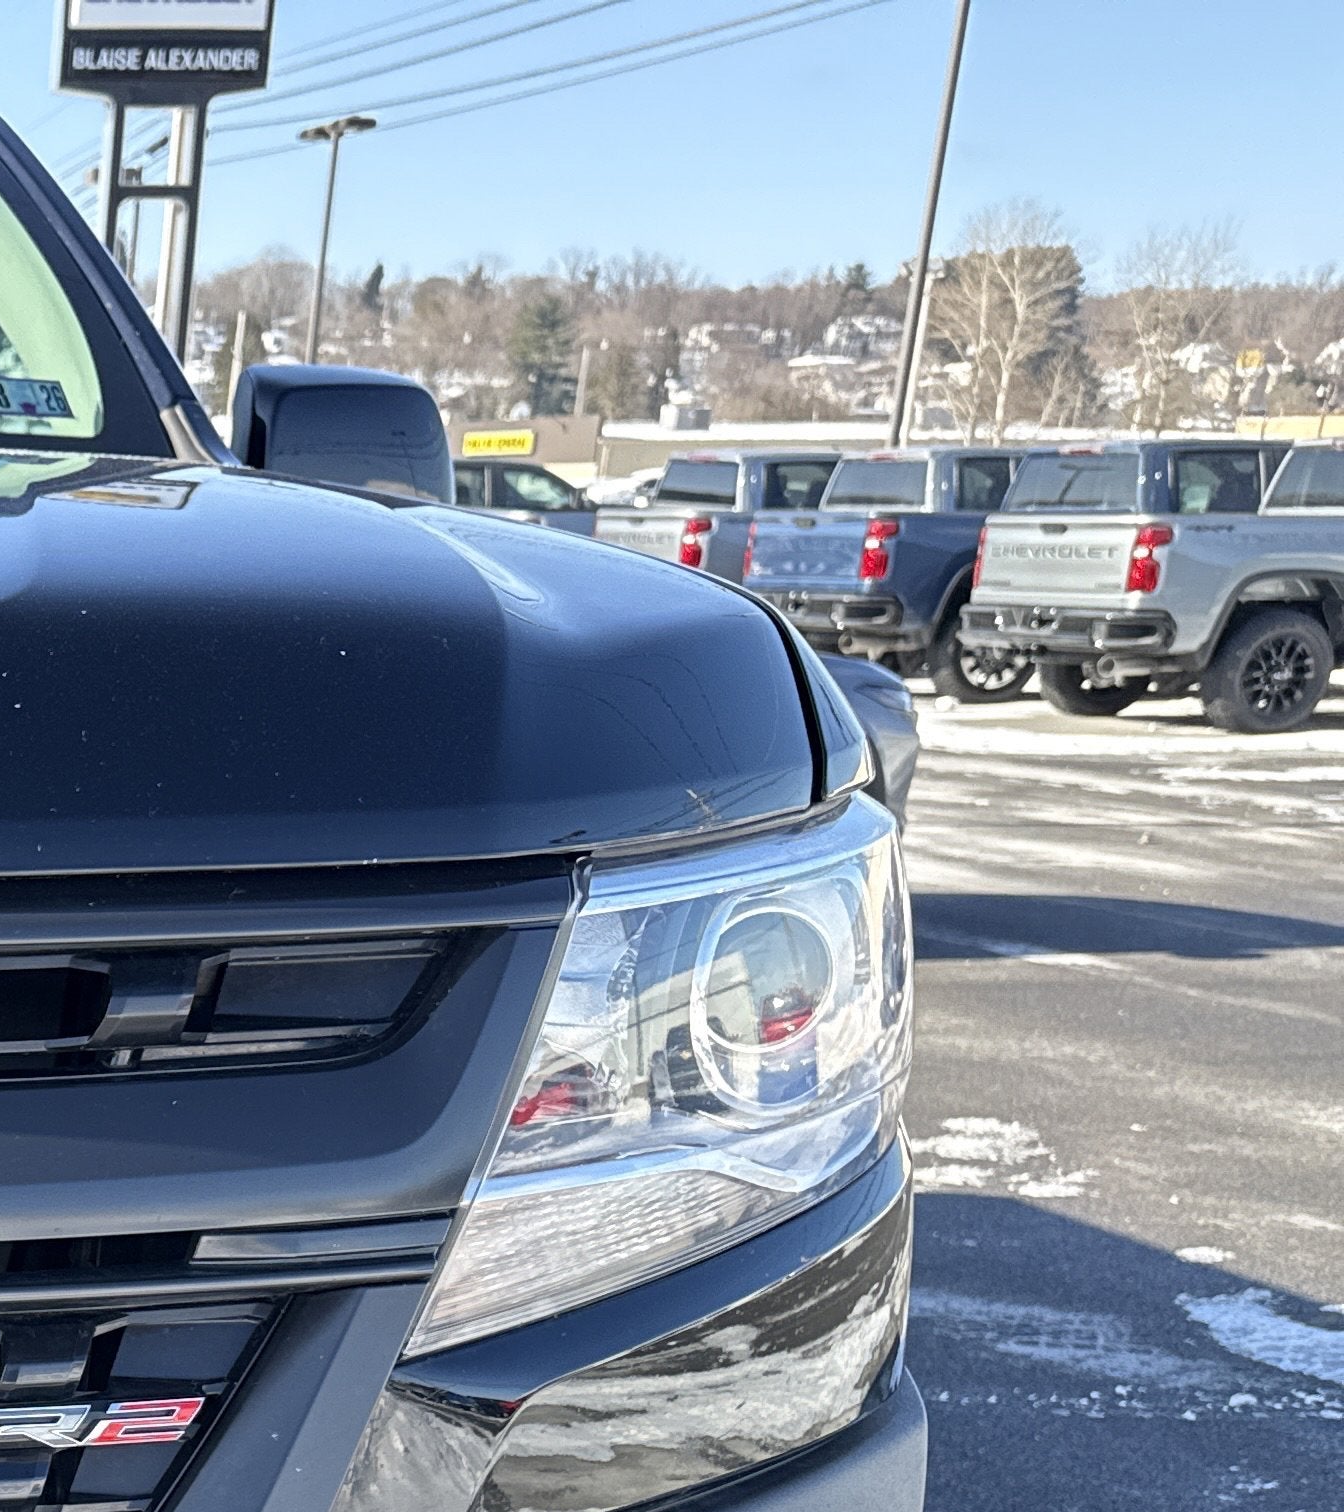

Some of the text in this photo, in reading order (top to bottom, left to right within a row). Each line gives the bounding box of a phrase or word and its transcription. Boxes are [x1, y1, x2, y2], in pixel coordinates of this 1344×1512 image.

[72, 47, 259, 71] BLAISE ALEXANDER
[990, 544, 1118, 560] CHEVROLET
